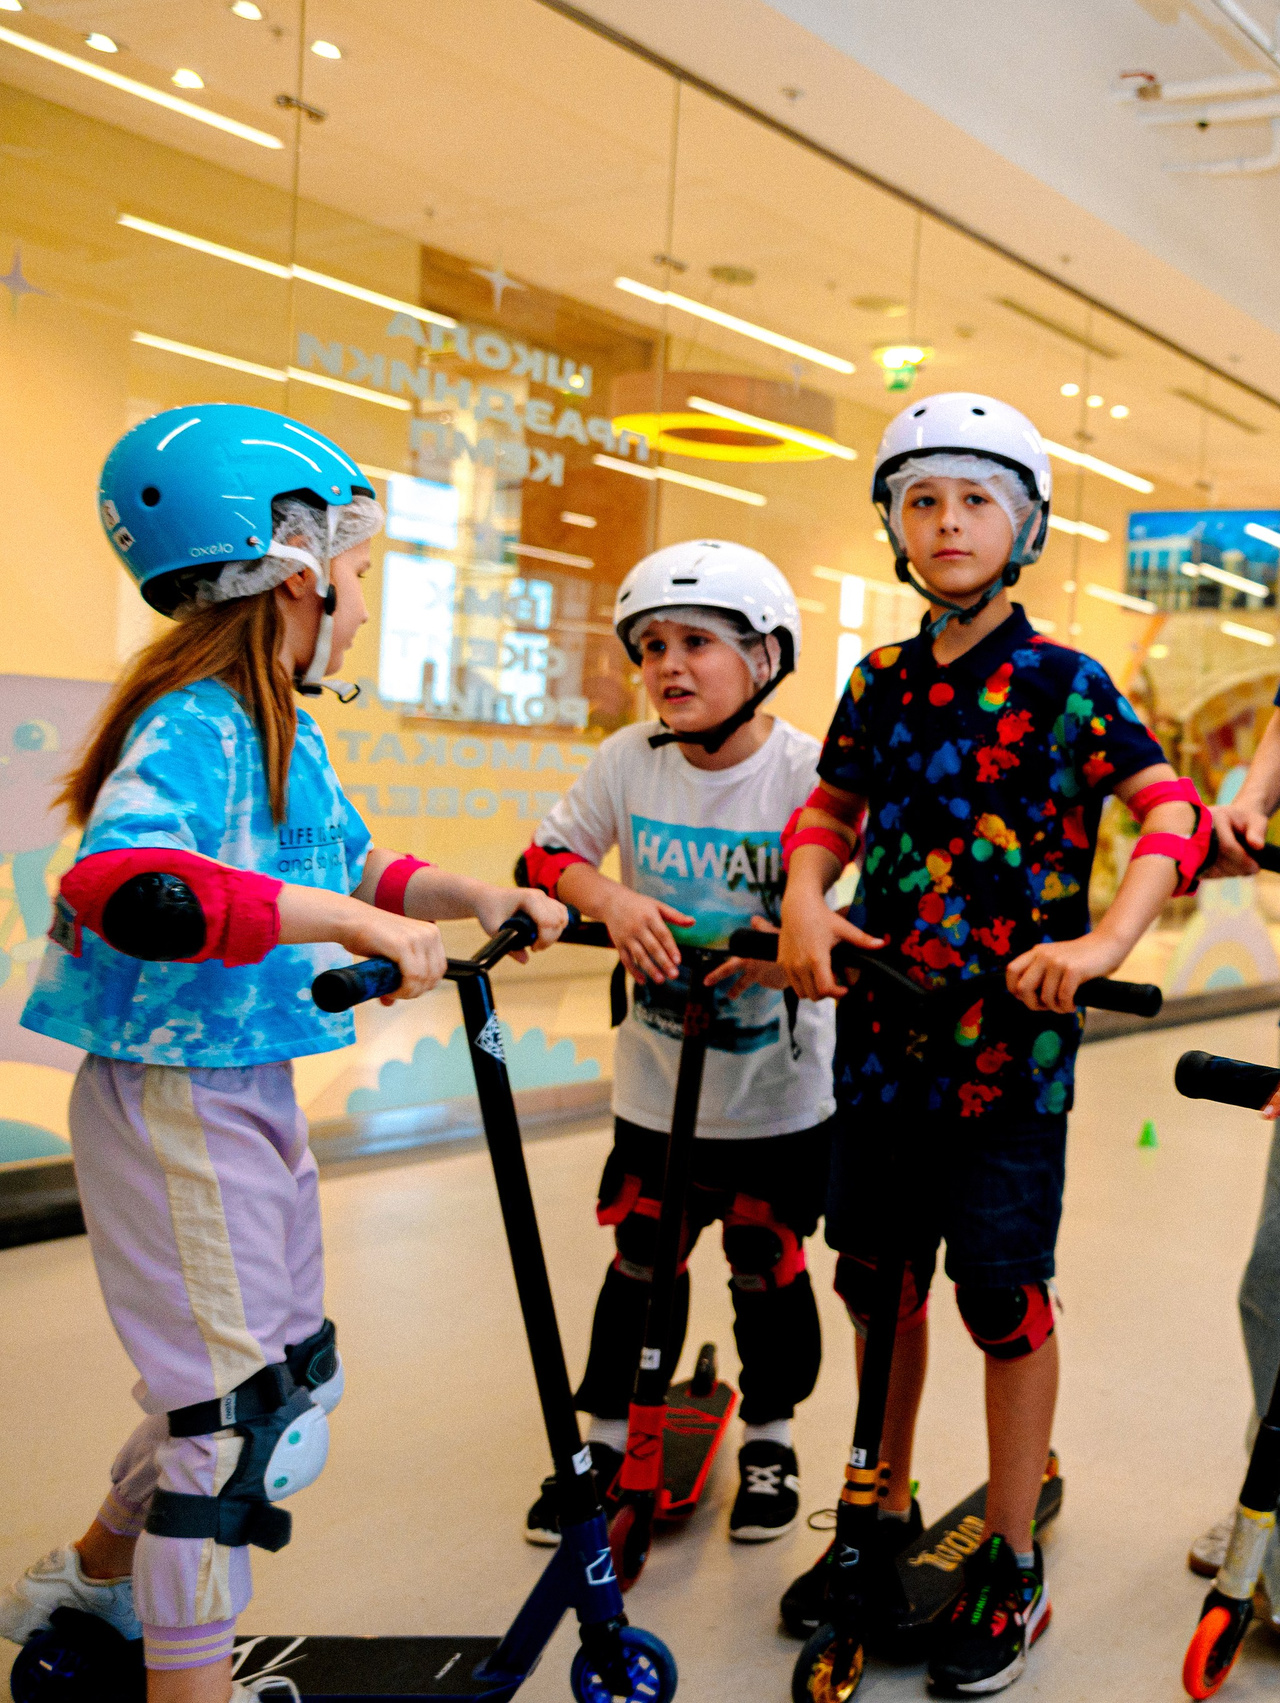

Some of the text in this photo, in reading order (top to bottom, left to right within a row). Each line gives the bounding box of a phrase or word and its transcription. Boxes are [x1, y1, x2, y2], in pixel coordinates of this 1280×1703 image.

[190, 543, 234, 558] oxelo
[279, 828, 313, 846] LIFE
[638, 830, 779, 884] HAWAII
